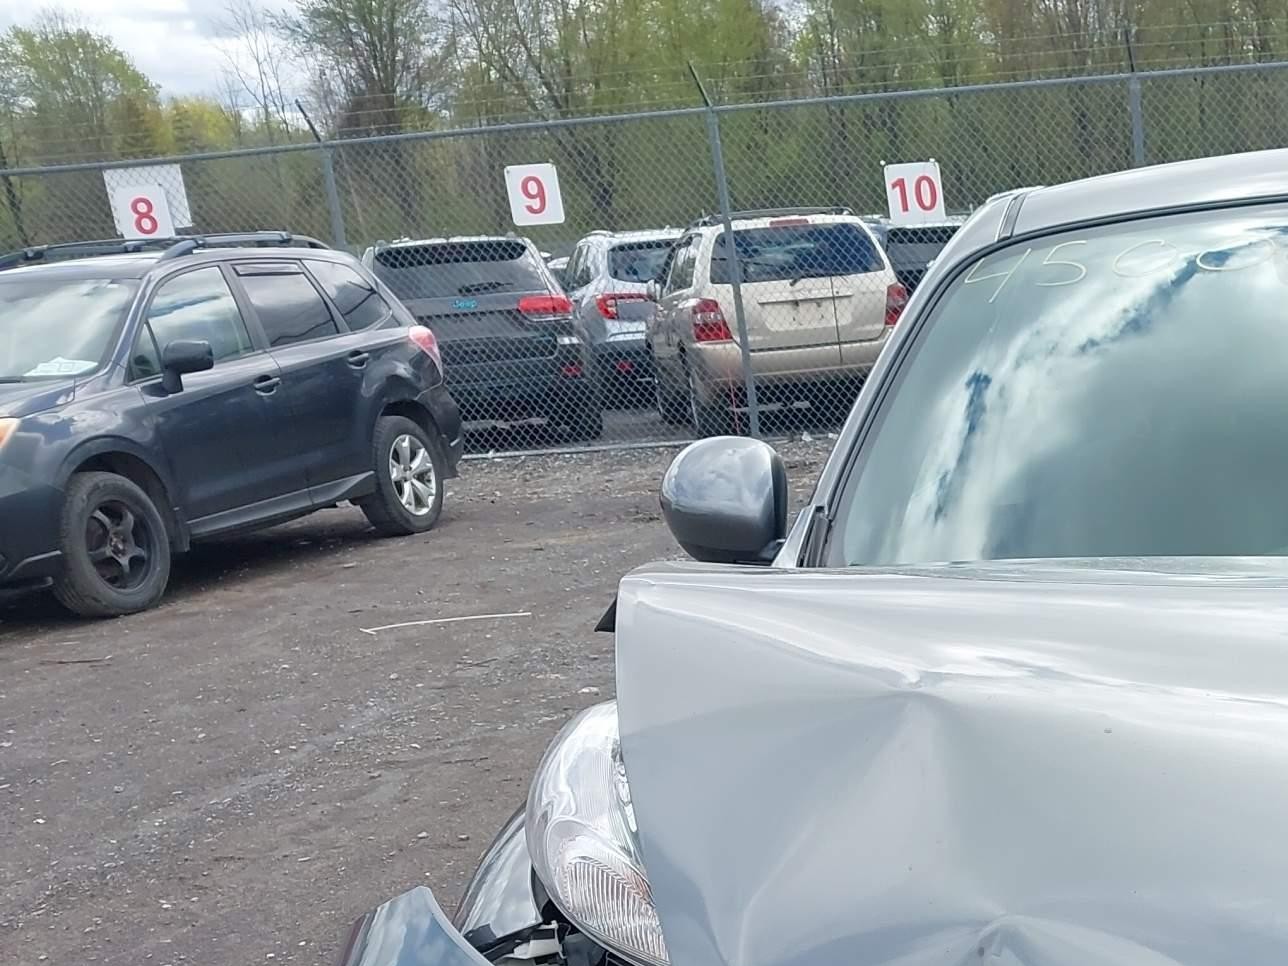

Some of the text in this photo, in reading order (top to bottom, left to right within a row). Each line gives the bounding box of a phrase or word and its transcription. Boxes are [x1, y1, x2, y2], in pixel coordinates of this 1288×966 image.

[521, 176, 546, 214] 9
[891, 175, 938, 212] 10
[131, 198, 158, 235] 8
[453, 299, 477, 309] Jeep
